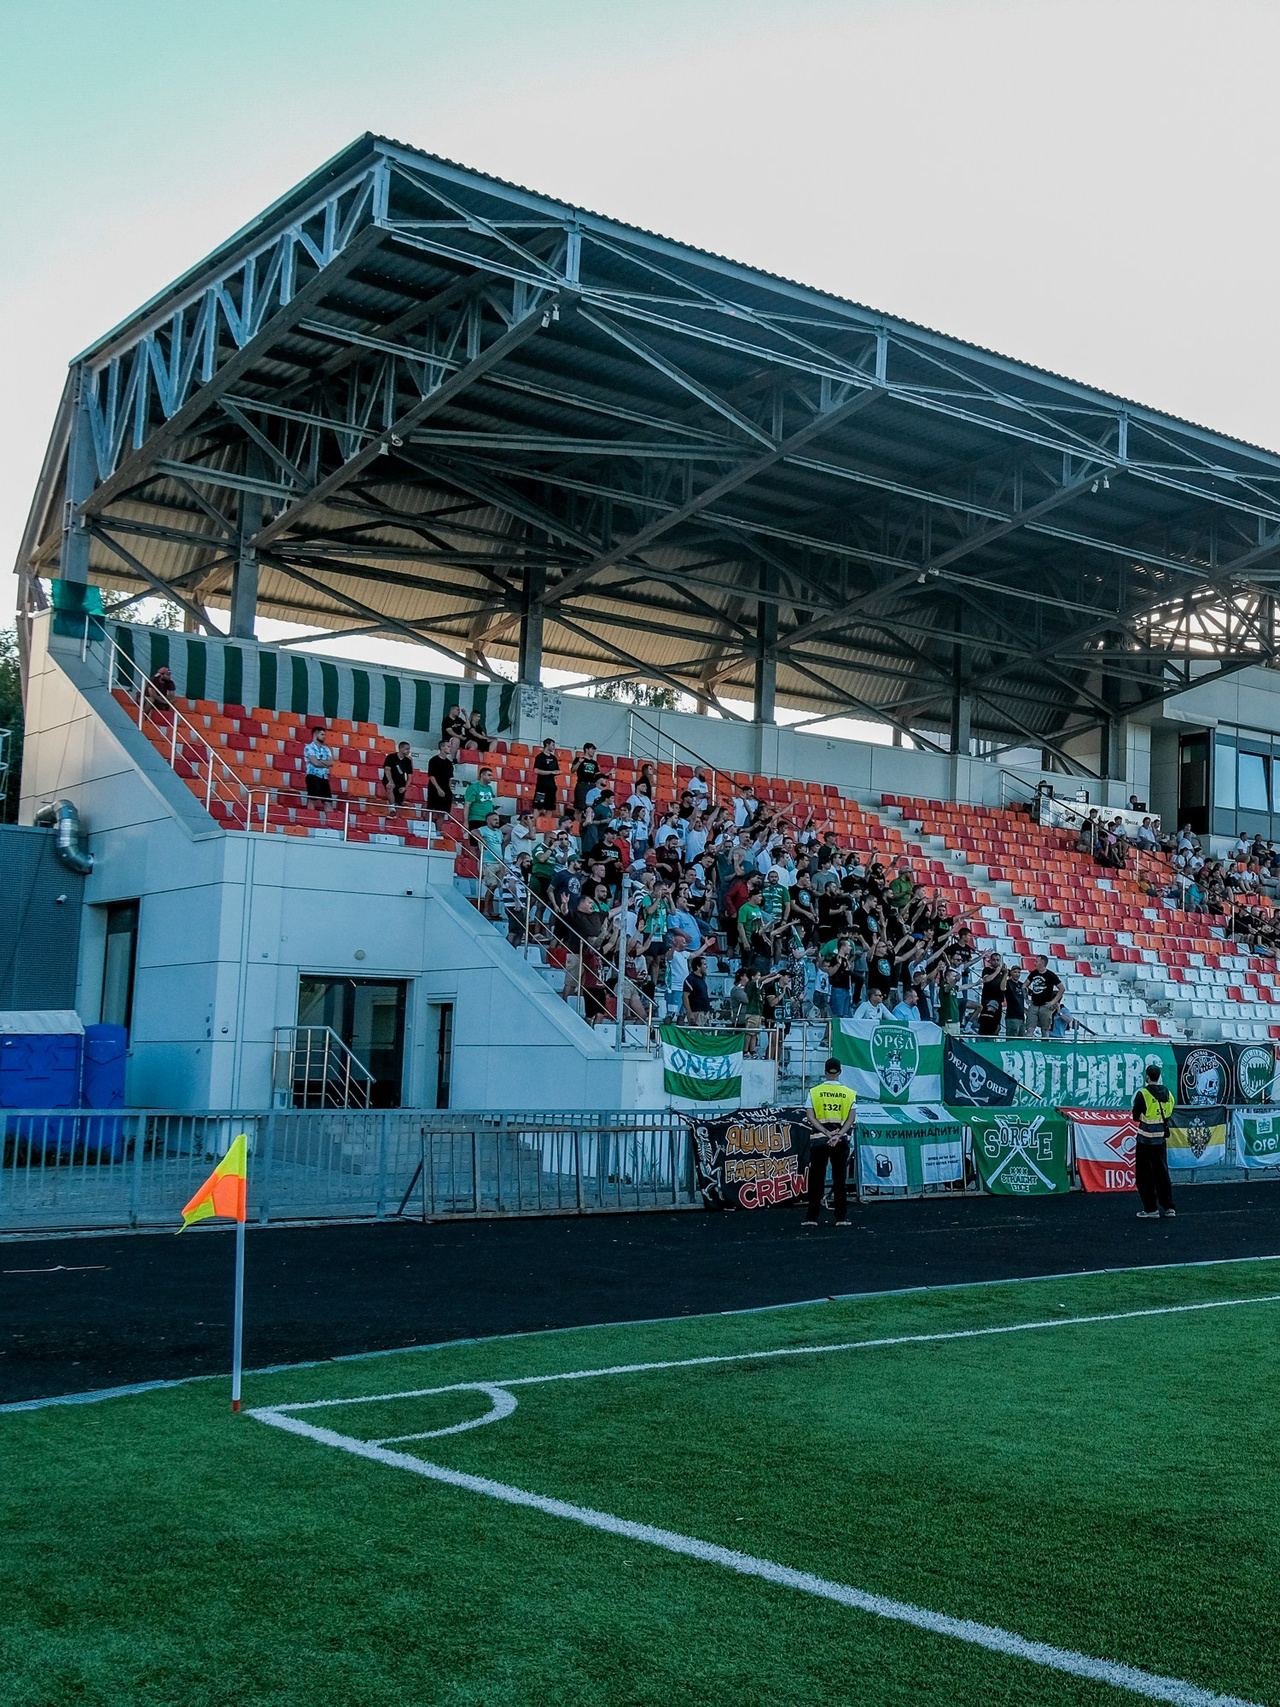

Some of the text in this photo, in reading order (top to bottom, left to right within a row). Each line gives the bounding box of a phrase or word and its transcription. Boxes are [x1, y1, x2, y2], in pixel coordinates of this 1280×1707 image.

[819, 1091, 847, 1099] STEWARD
[886, 1126, 960, 1139] КРИМИНАЛИТИ
[738, 1166, 810, 1209] CREW
